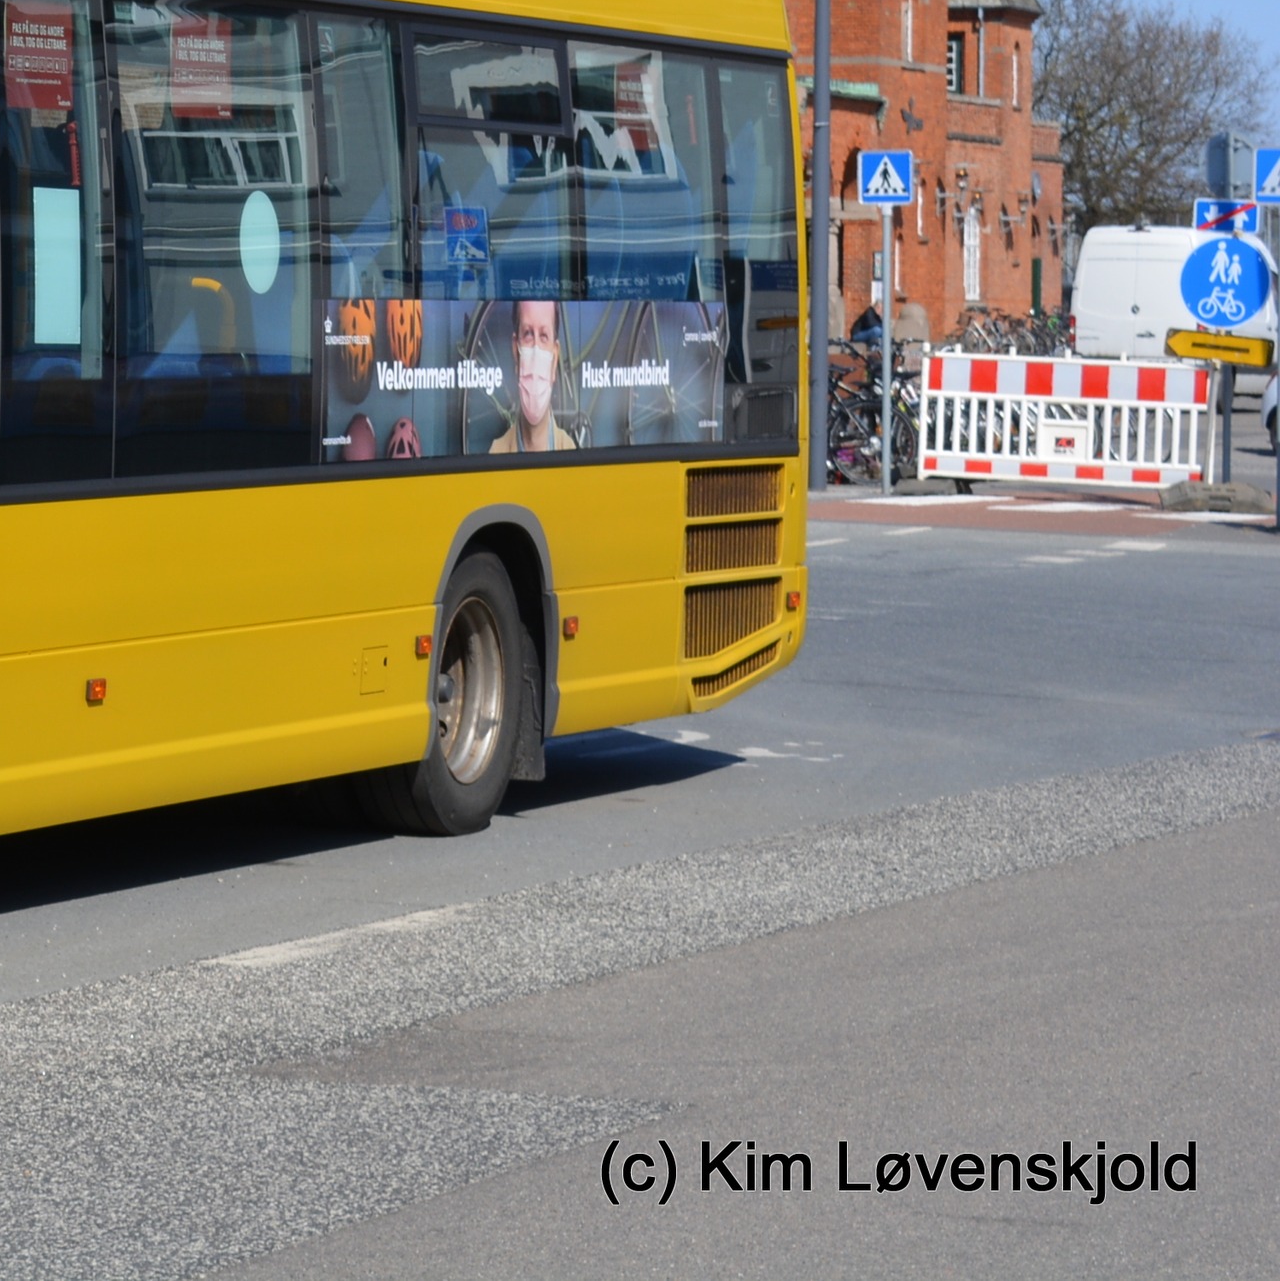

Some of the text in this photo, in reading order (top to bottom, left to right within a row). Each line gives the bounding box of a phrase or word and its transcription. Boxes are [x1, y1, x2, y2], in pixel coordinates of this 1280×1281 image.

[376, 360, 503, 396] Velkommen tilbage
[581, 359, 670, 388] Husk mundbind
